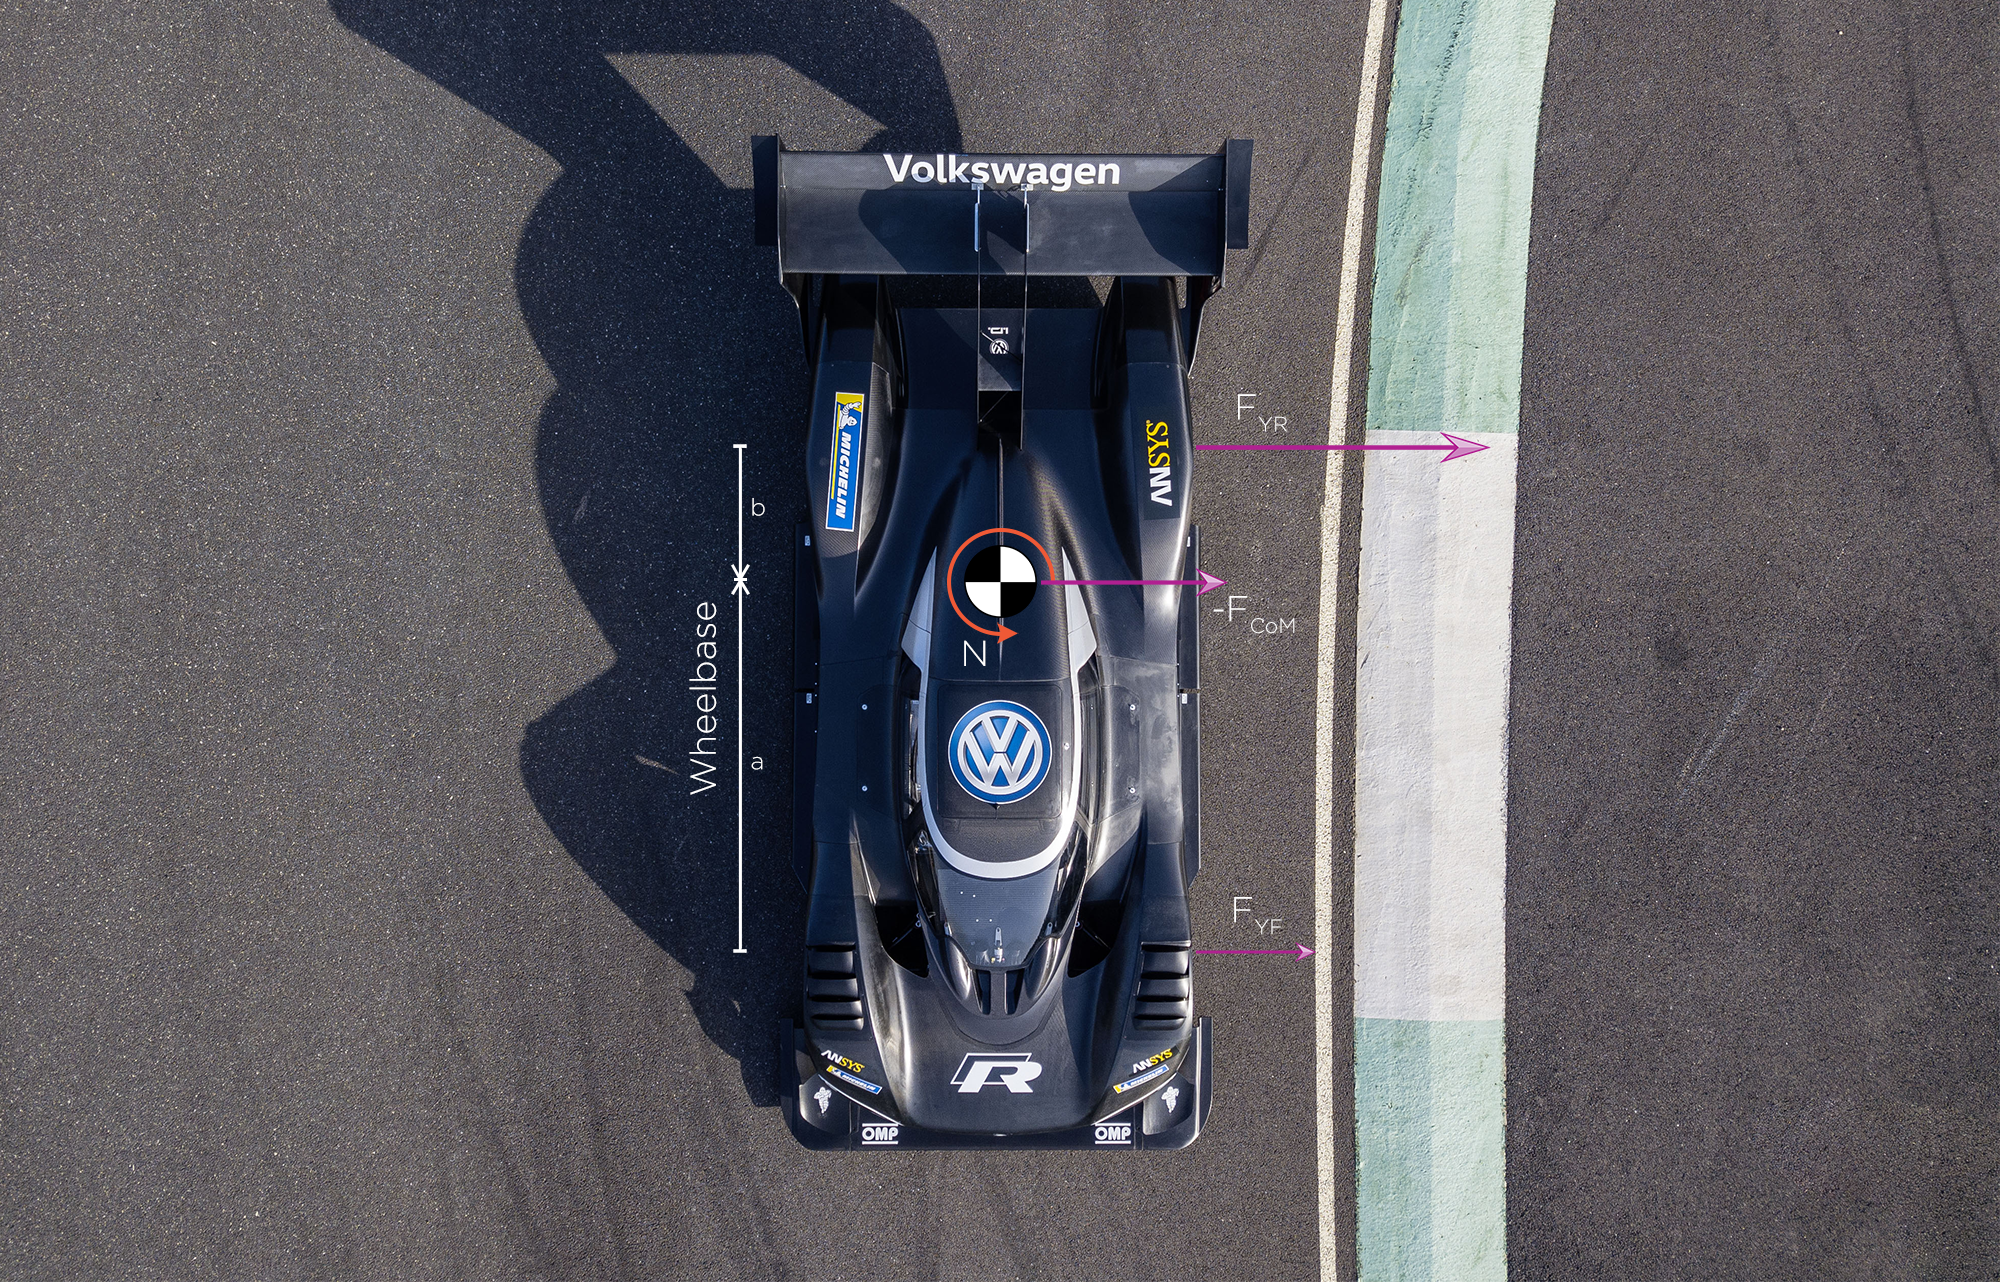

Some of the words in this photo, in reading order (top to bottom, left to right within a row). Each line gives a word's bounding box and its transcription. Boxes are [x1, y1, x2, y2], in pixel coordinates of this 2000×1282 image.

[883, 154, 1120, 191] Volkswagen
[835, 431, 852, 519] MICHELIN
[1146, 420, 1173, 507] ANSYS
[955, 708, 1045, 797] VW
[821, 1049, 865, 1073] ANSYS
[956, 1060, 1042, 1093] R
[1133, 1048, 1173, 1074] ANSYS
[862, 1127, 899, 1141] OMP
[1094, 1126, 1131, 1141] OMP
